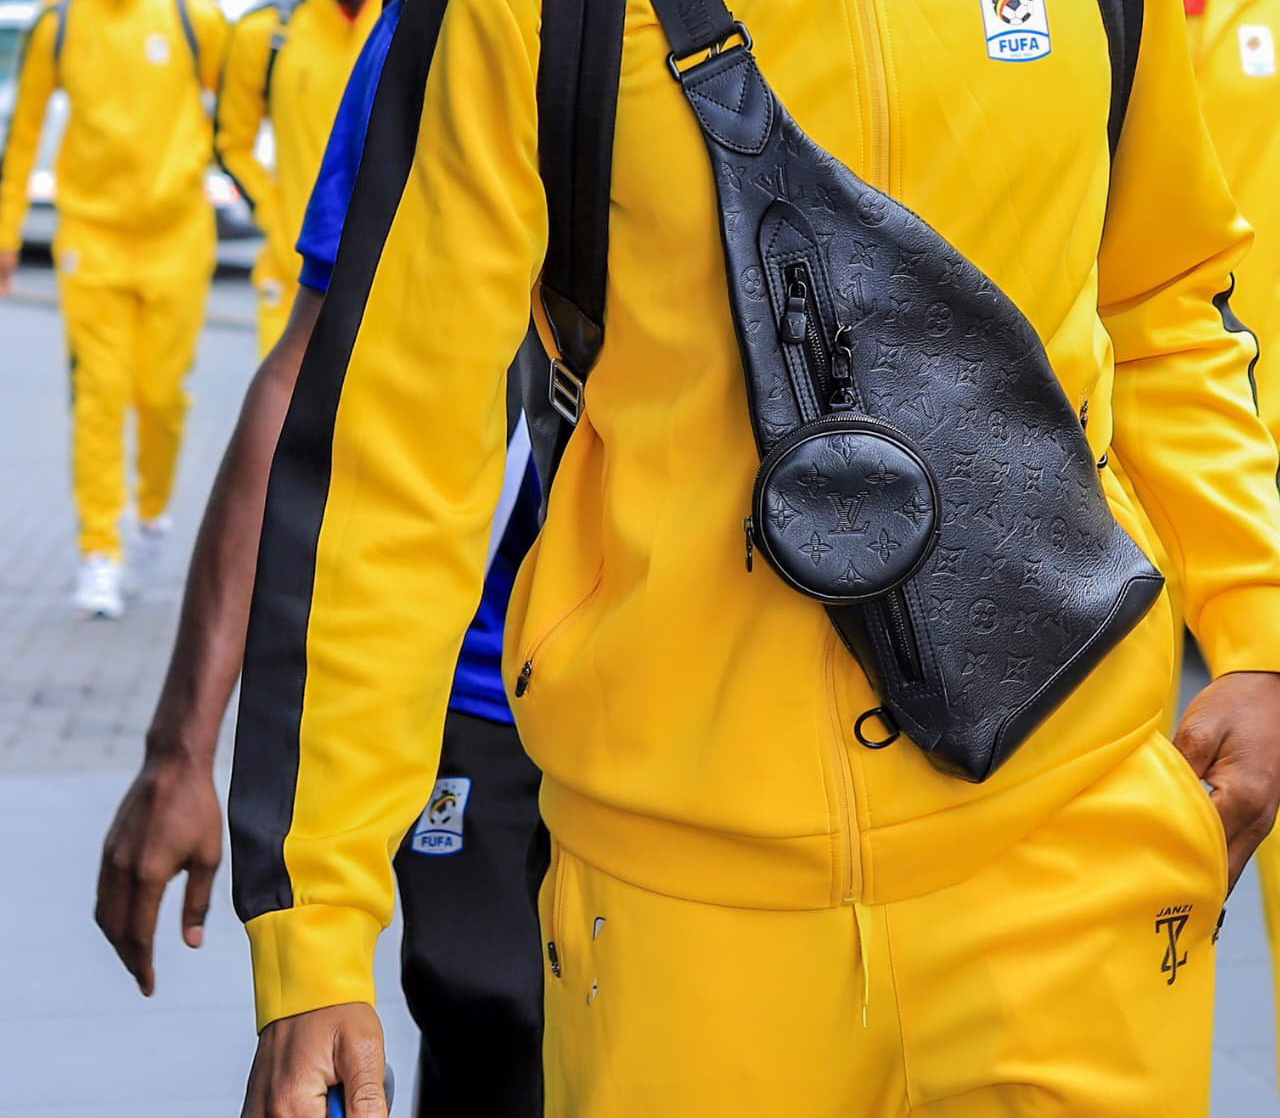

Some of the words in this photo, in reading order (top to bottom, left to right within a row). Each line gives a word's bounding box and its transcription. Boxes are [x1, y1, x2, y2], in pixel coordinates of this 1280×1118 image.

[998, 37, 1040, 53] FUFA
[421, 836, 453, 847] FUFA
[1156, 904, 1193, 918] JANZI
